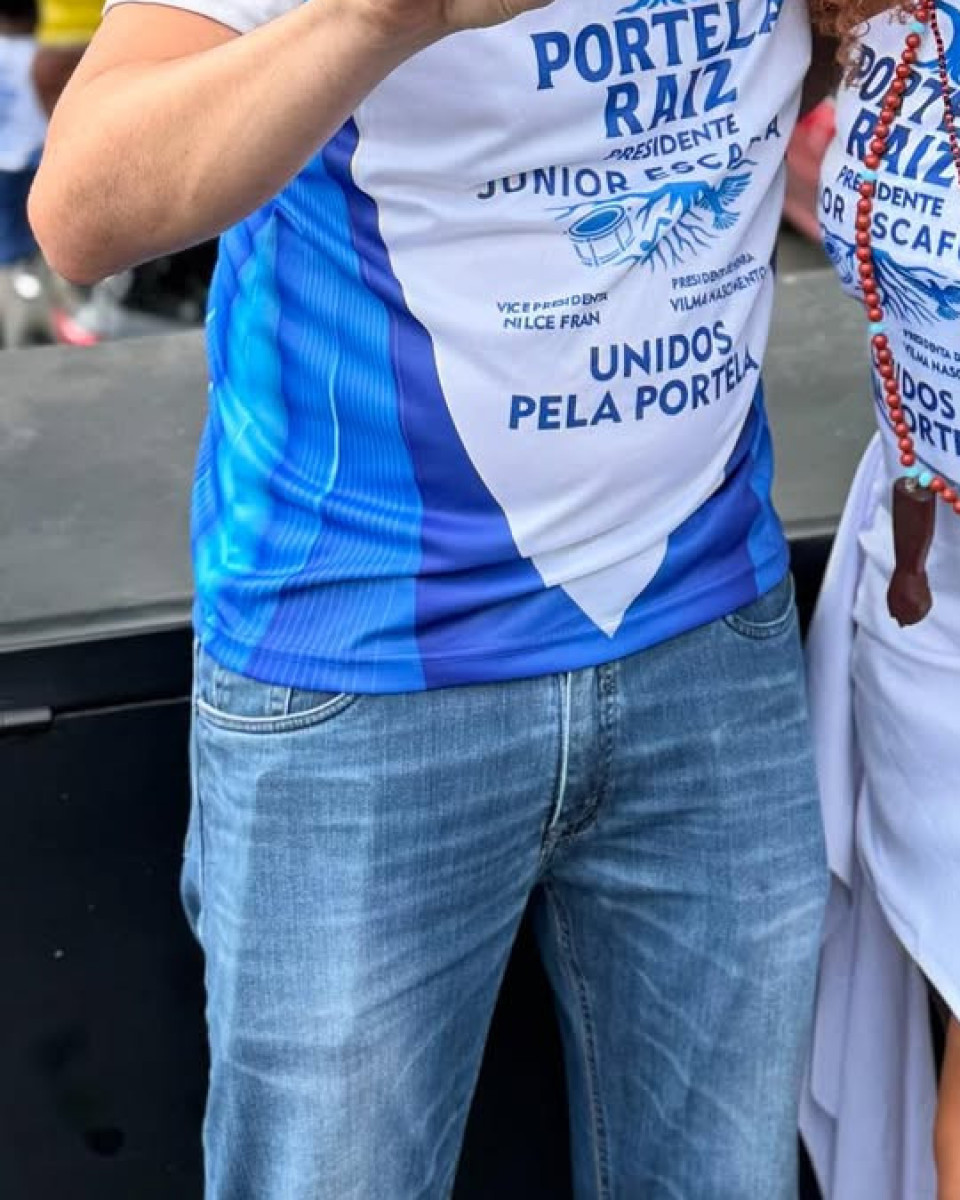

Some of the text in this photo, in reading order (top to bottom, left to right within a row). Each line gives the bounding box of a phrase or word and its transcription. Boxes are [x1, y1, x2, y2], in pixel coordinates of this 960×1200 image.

[605, 59, 737, 138] RAIZ
[604, 114, 740, 161] PRESIDENTE
[846, 107, 955, 187] RAIZ
[477, 165, 630, 200] JUNIOR
[836, 165, 946, 217] PREIDENTE
[504, 310, 599, 330] NILCE FRAN
[589, 320, 733, 382] UNIDOS
[509, 348, 760, 430] PELA PORTELA
